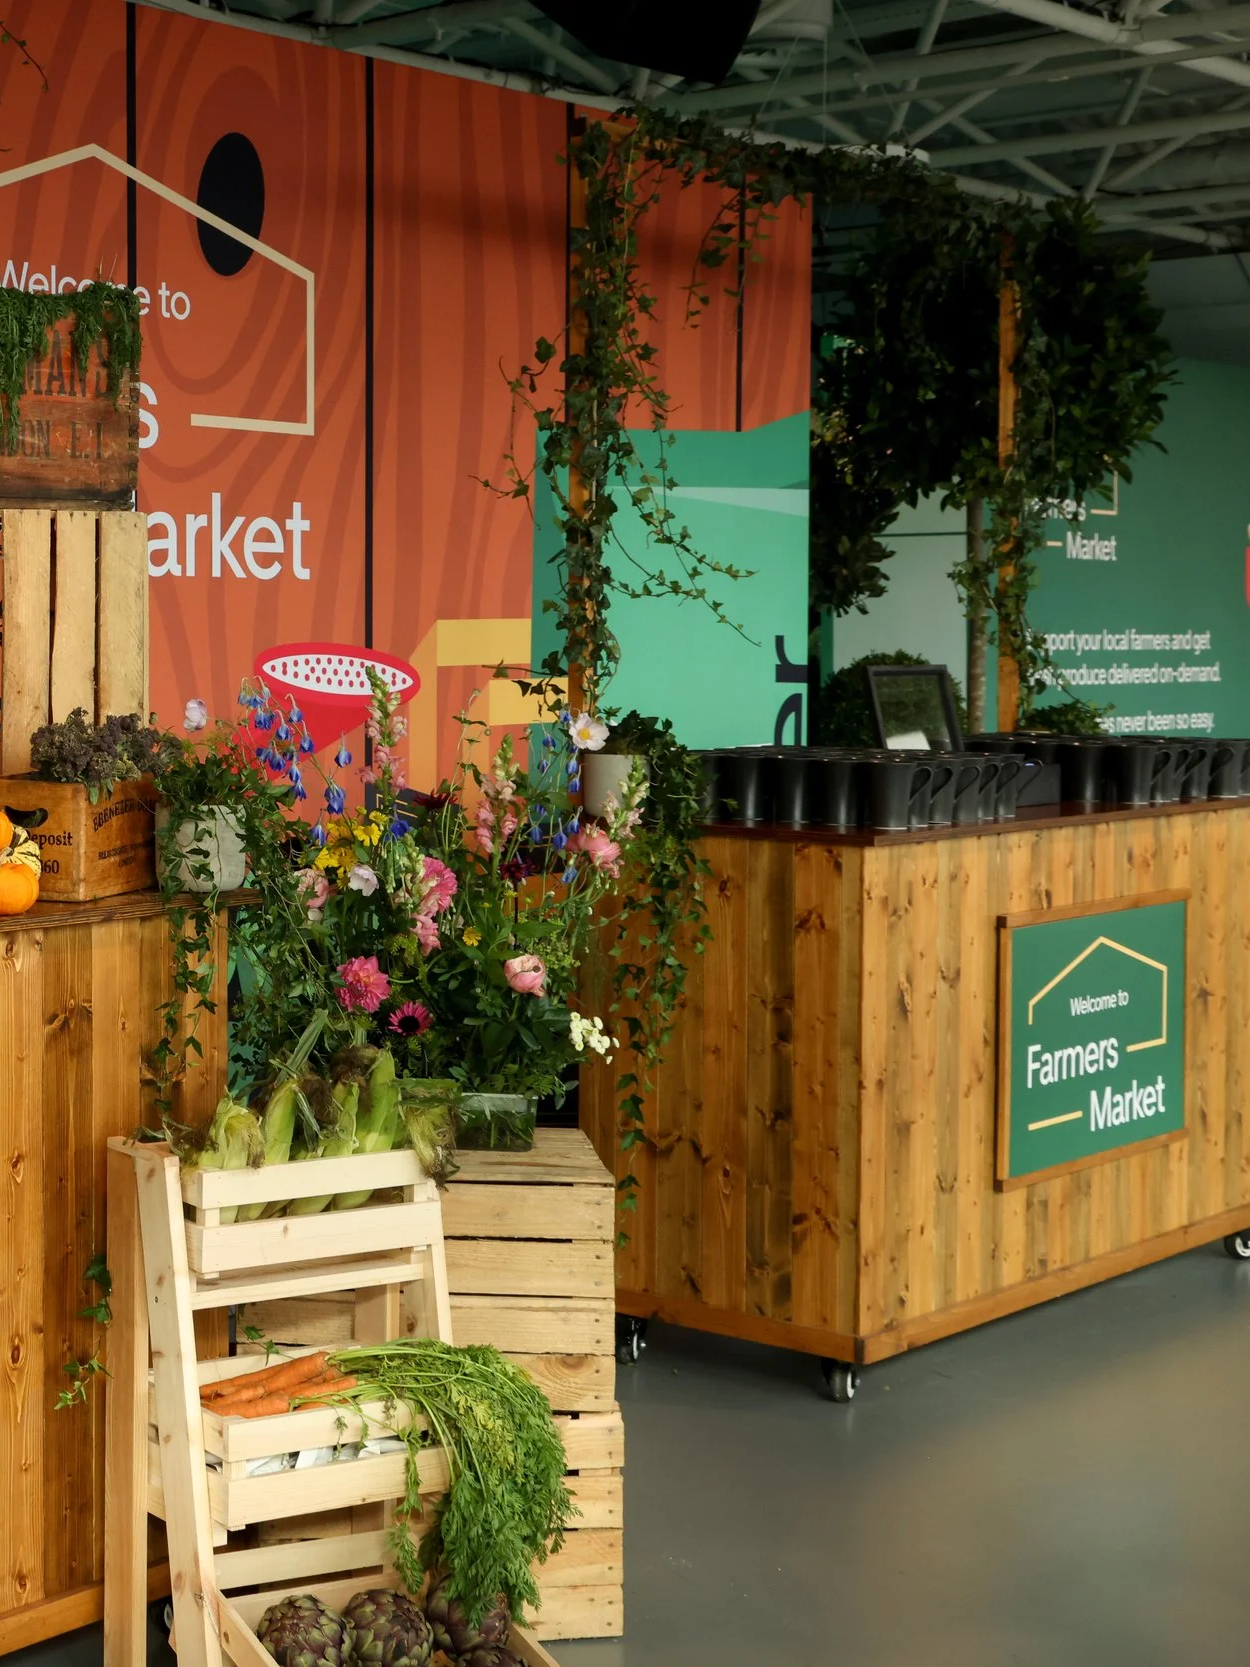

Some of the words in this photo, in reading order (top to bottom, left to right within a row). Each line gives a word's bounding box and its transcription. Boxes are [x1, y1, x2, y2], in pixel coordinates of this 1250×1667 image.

[158, 282, 190, 320] to
[147, 492, 311, 580] arket
[1066, 531, 1117, 561] Market
[1028, 628, 1075, 656] pport
[1075, 632, 1102, 656] your
[1102, 629, 1129, 650] local
[1130, 628, 1171, 650] farmers
[1171, 629, 1192, 650] and
[1193, 630, 1211, 655] get
[1108, 662, 1159, 684] delivered
[1159, 661, 1222, 683] on-demand.
[1096, 716, 1116, 733] as
[1116, 714, 1147, 733] never
[1147, 710, 1175, 731] been
[1175, 712, 1190, 730] so
[1190, 711, 1215, 733] easy.
[1070, 995, 1117, 1016] Welcome
[1116, 989, 1129, 1006] to
[1027, 1036, 1119, 1089] Farmers
[1090, 1075, 1165, 1132] Market
